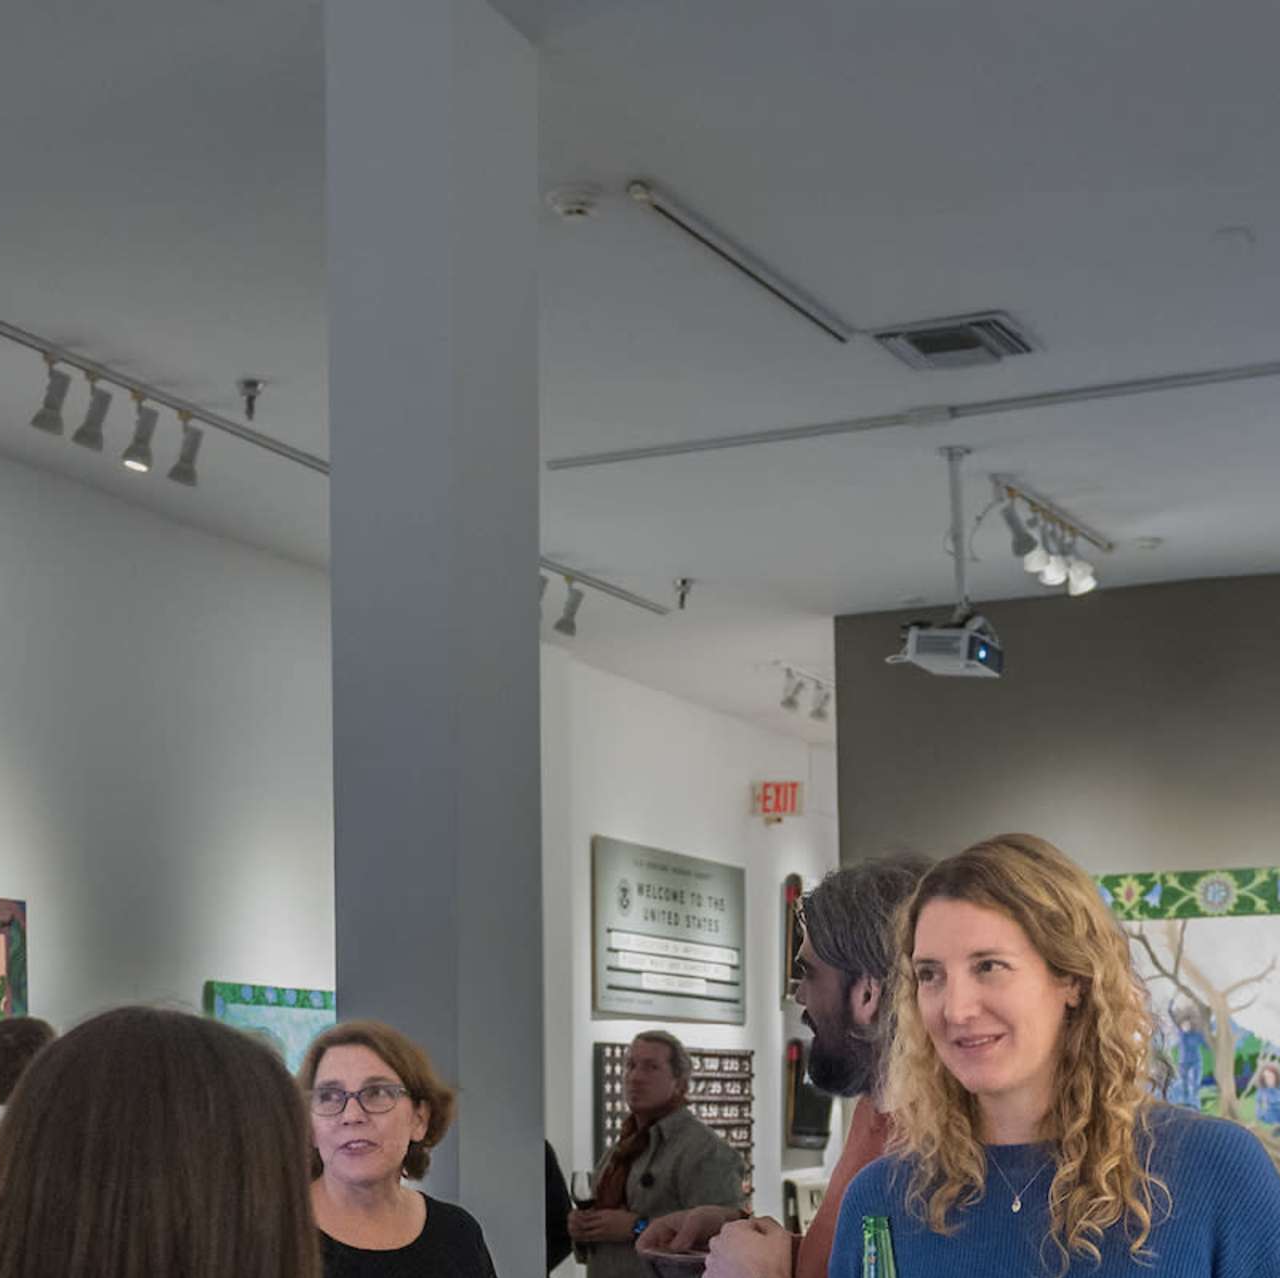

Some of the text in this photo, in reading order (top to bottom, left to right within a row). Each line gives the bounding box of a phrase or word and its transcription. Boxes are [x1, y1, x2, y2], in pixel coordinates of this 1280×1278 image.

[762, 782, 799, 813] EXIT
[637, 883, 725, 912] WELCOME TO THE
[643, 907, 719, 933] UNITED STATES
